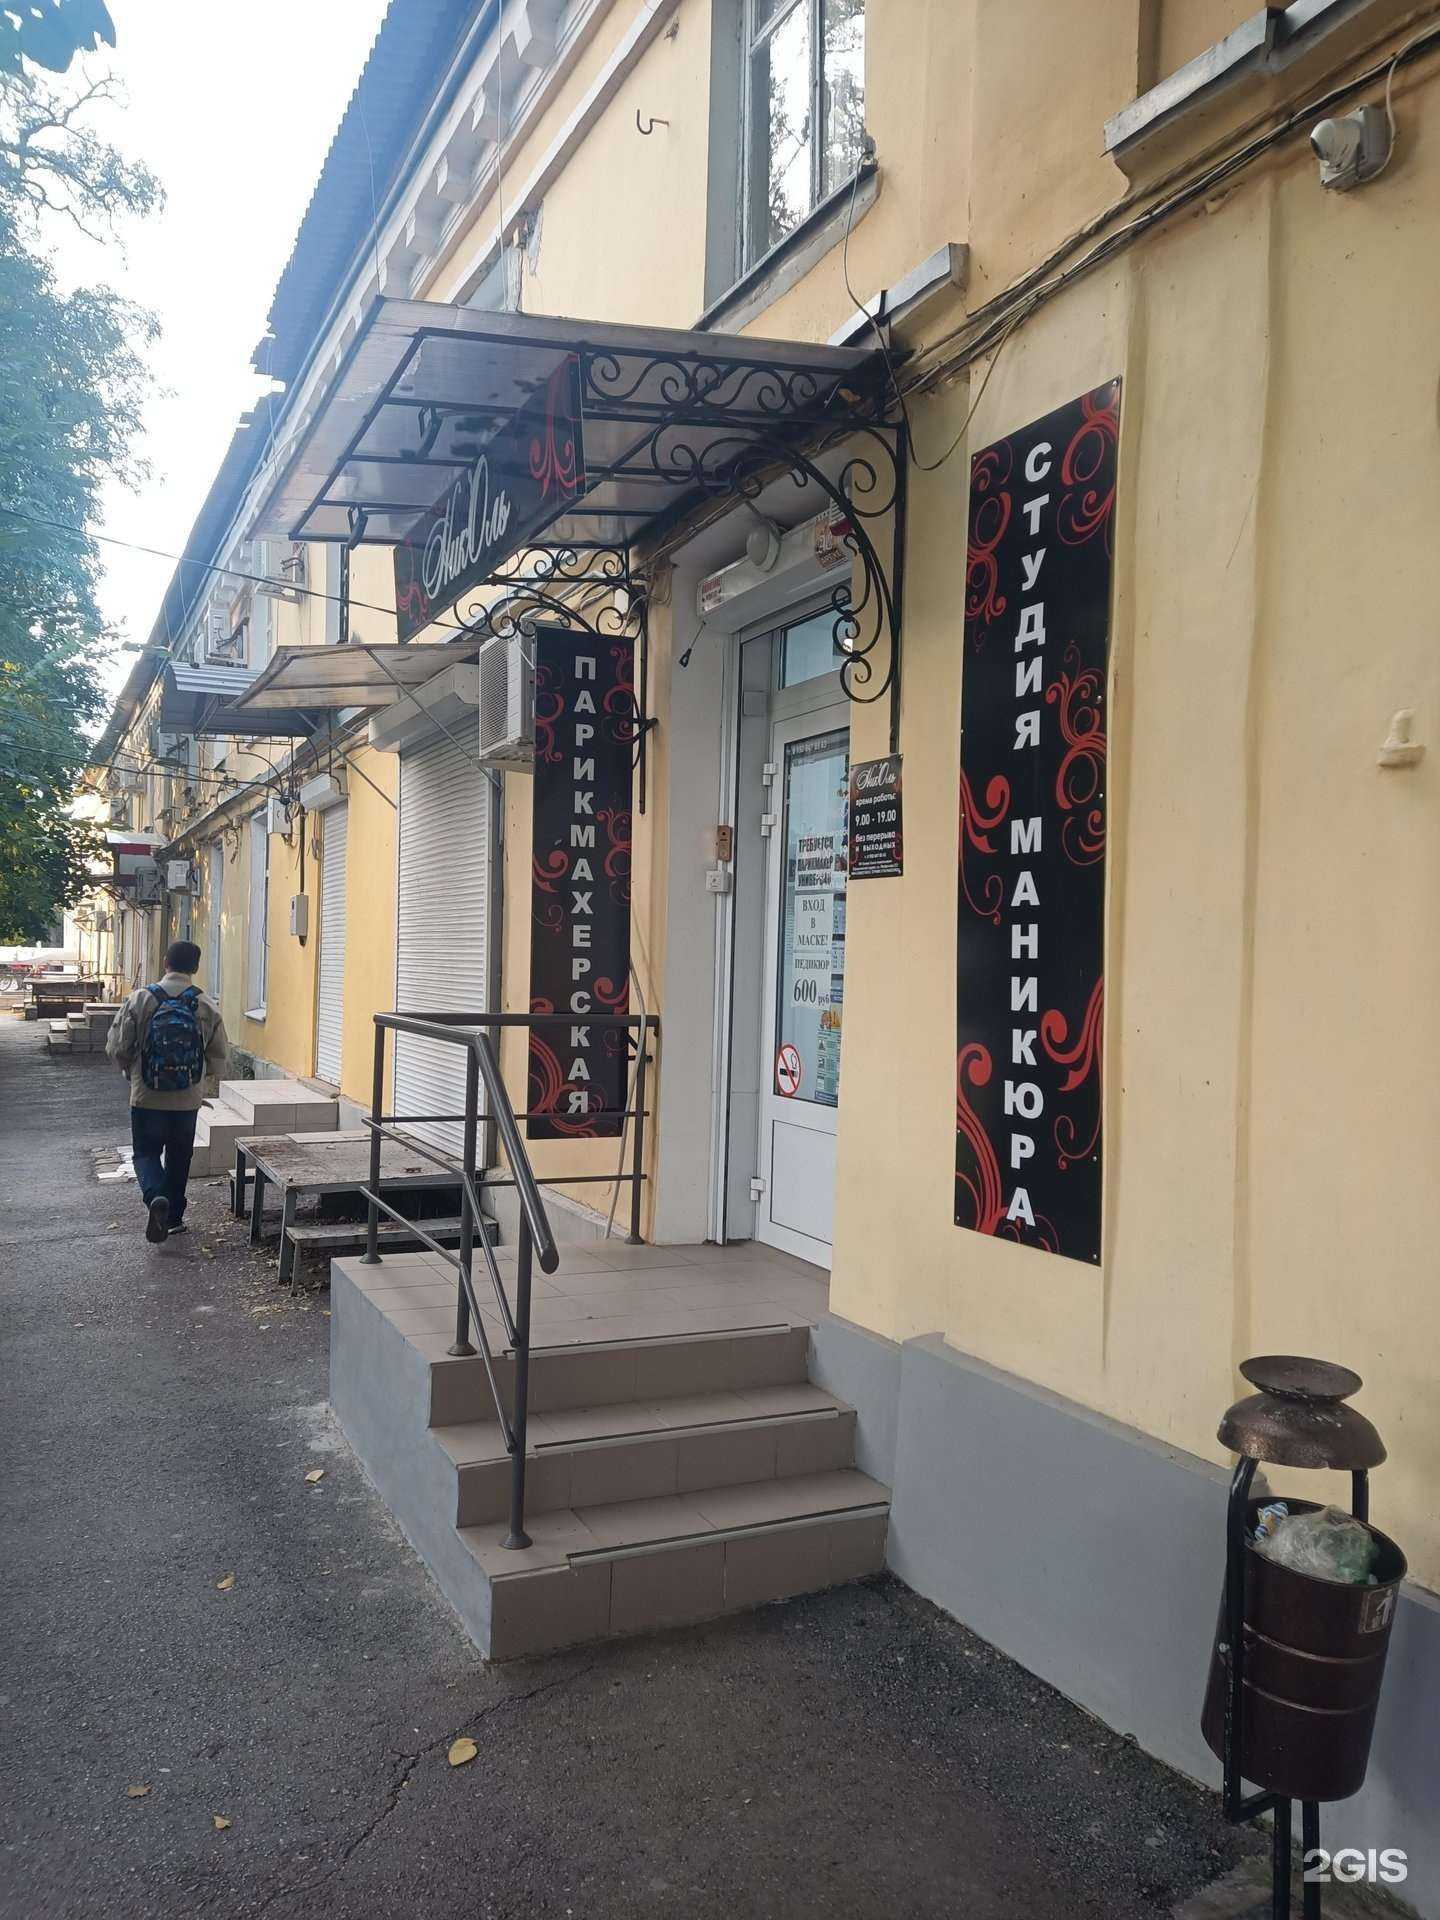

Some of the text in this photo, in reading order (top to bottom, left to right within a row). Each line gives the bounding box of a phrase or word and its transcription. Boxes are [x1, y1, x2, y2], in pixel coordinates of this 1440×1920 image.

[855, 813, 870, 827] 9.00
[877, 809, 897, 824] 19.00
[855, 833, 866, 843] без
[866, 831, 896, 842] перерыва
[1003, 441, 1053, 1227] СТУДИЯ МАНИКЮРА
[863, 841, 896, 852] выходных
[567, 655, 597, 1114] ПАРИКМАХЕРСКАЯ
[802, 899, 826, 912] ВХОД
[810, 917, 816, 929] В
[797, 934, 829, 946] МАСКЕ!
[794, 958, 830, 970] ПЕДИКЮР
[793, 979, 817, 1003] 600
